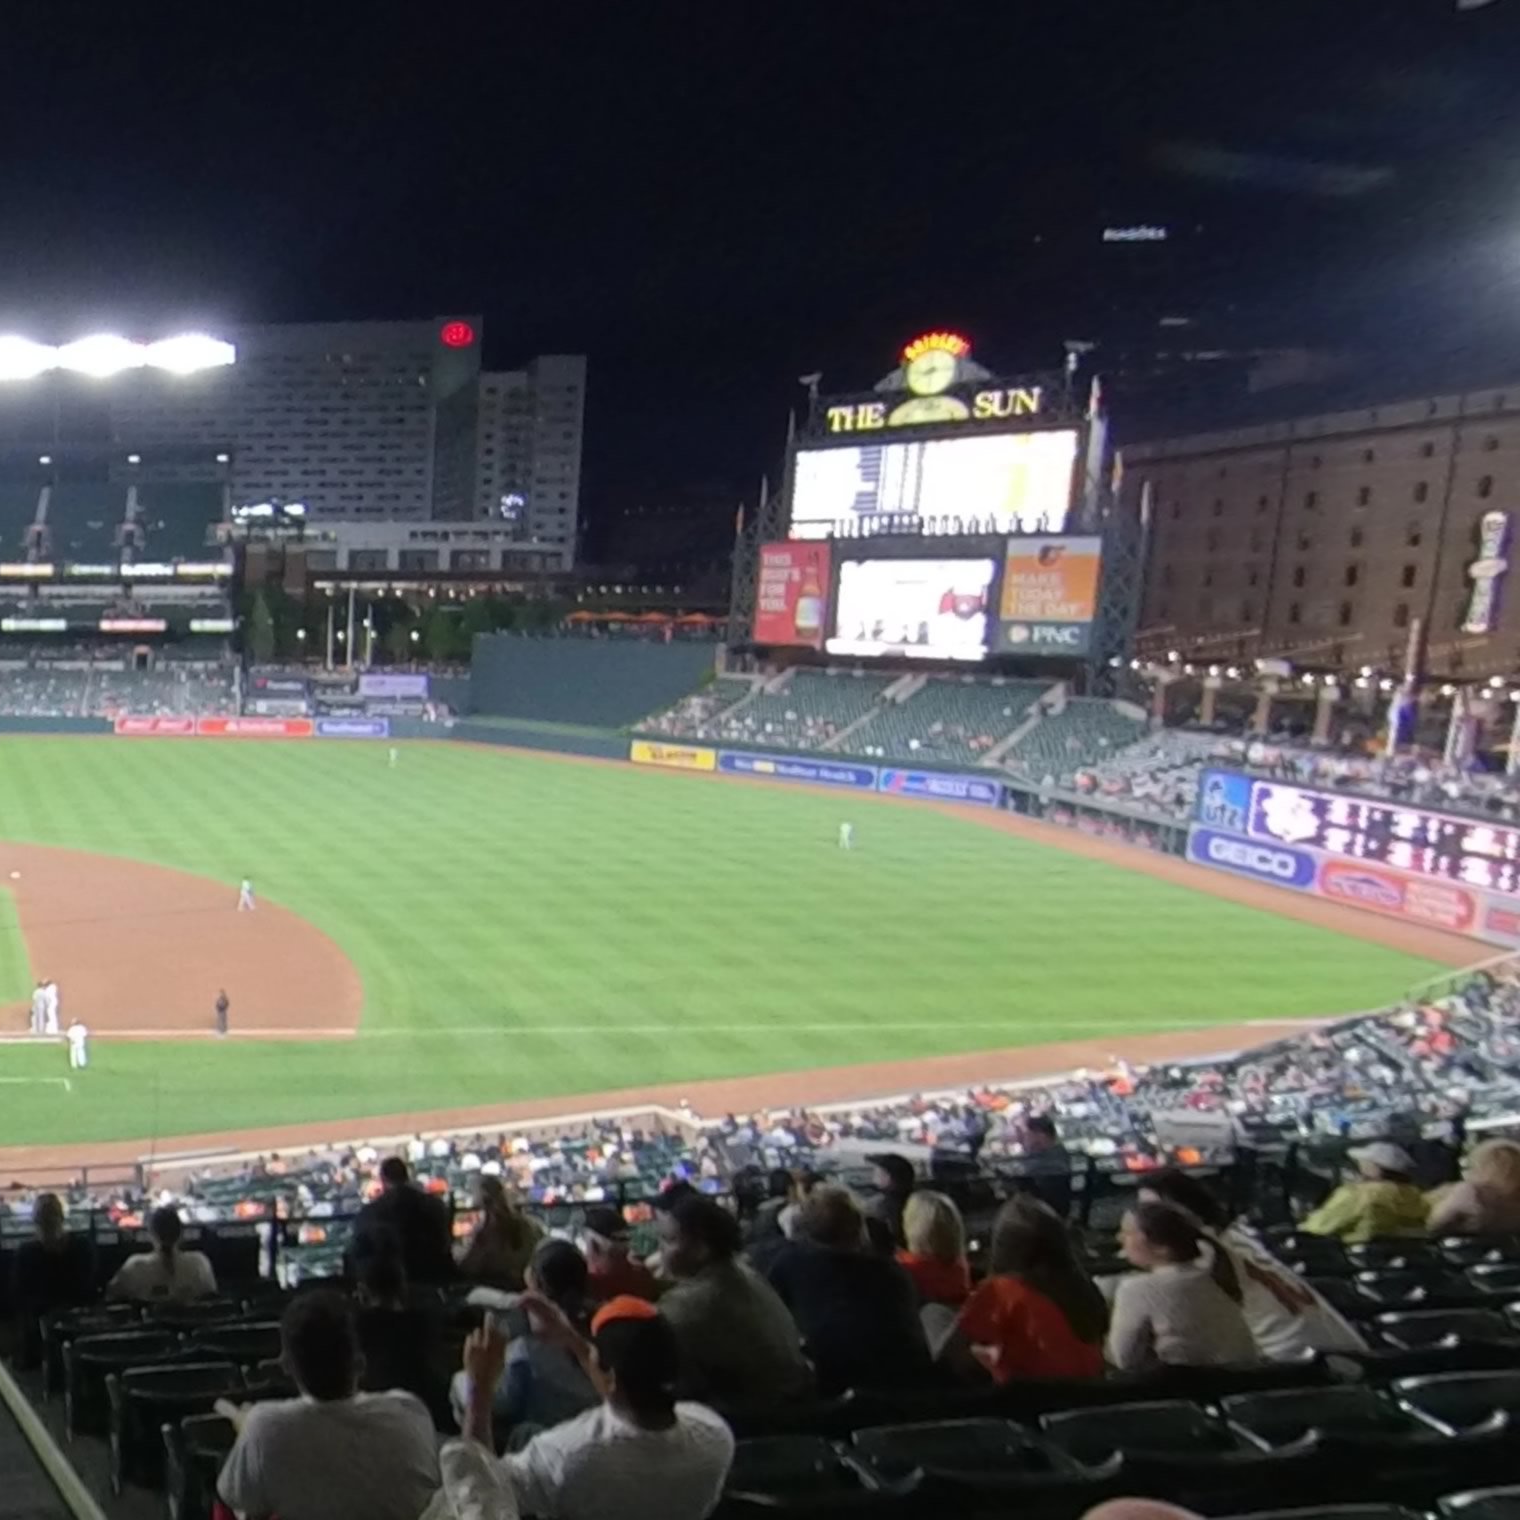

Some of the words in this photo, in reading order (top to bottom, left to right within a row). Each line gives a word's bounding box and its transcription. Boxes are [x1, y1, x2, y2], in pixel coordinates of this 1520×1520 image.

[827, 403, 886, 432] THE
[973, 386, 1042, 419] SUN
[1011, 588, 1062, 602] TODAY
[1032, 625, 1081, 644] PNC
[1208, 837, 1297, 879] GEICO
